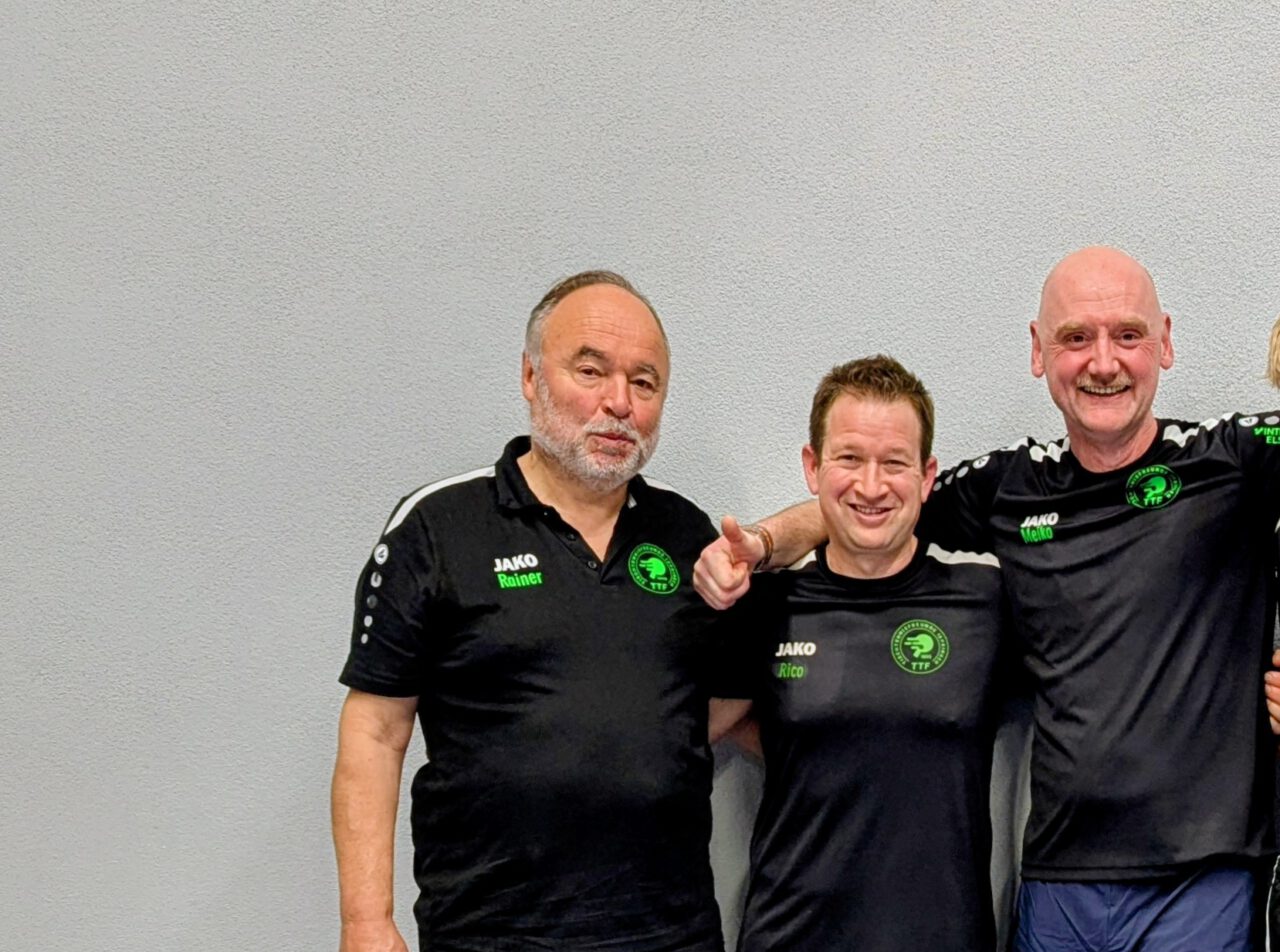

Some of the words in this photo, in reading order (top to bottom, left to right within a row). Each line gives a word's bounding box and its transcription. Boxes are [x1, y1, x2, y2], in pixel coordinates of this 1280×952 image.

[1144, 496, 1163, 506] TTF
[1020, 512, 1059, 528] JAKO
[494, 553, 538, 572] JAKO
[497, 572, 543, 588] Rainer
[650, 582, 668, 590] TTF
[775, 641, 817, 657] JAKO
[777, 662, 804, 678] Rico
[911, 662, 931, 671] TTF
